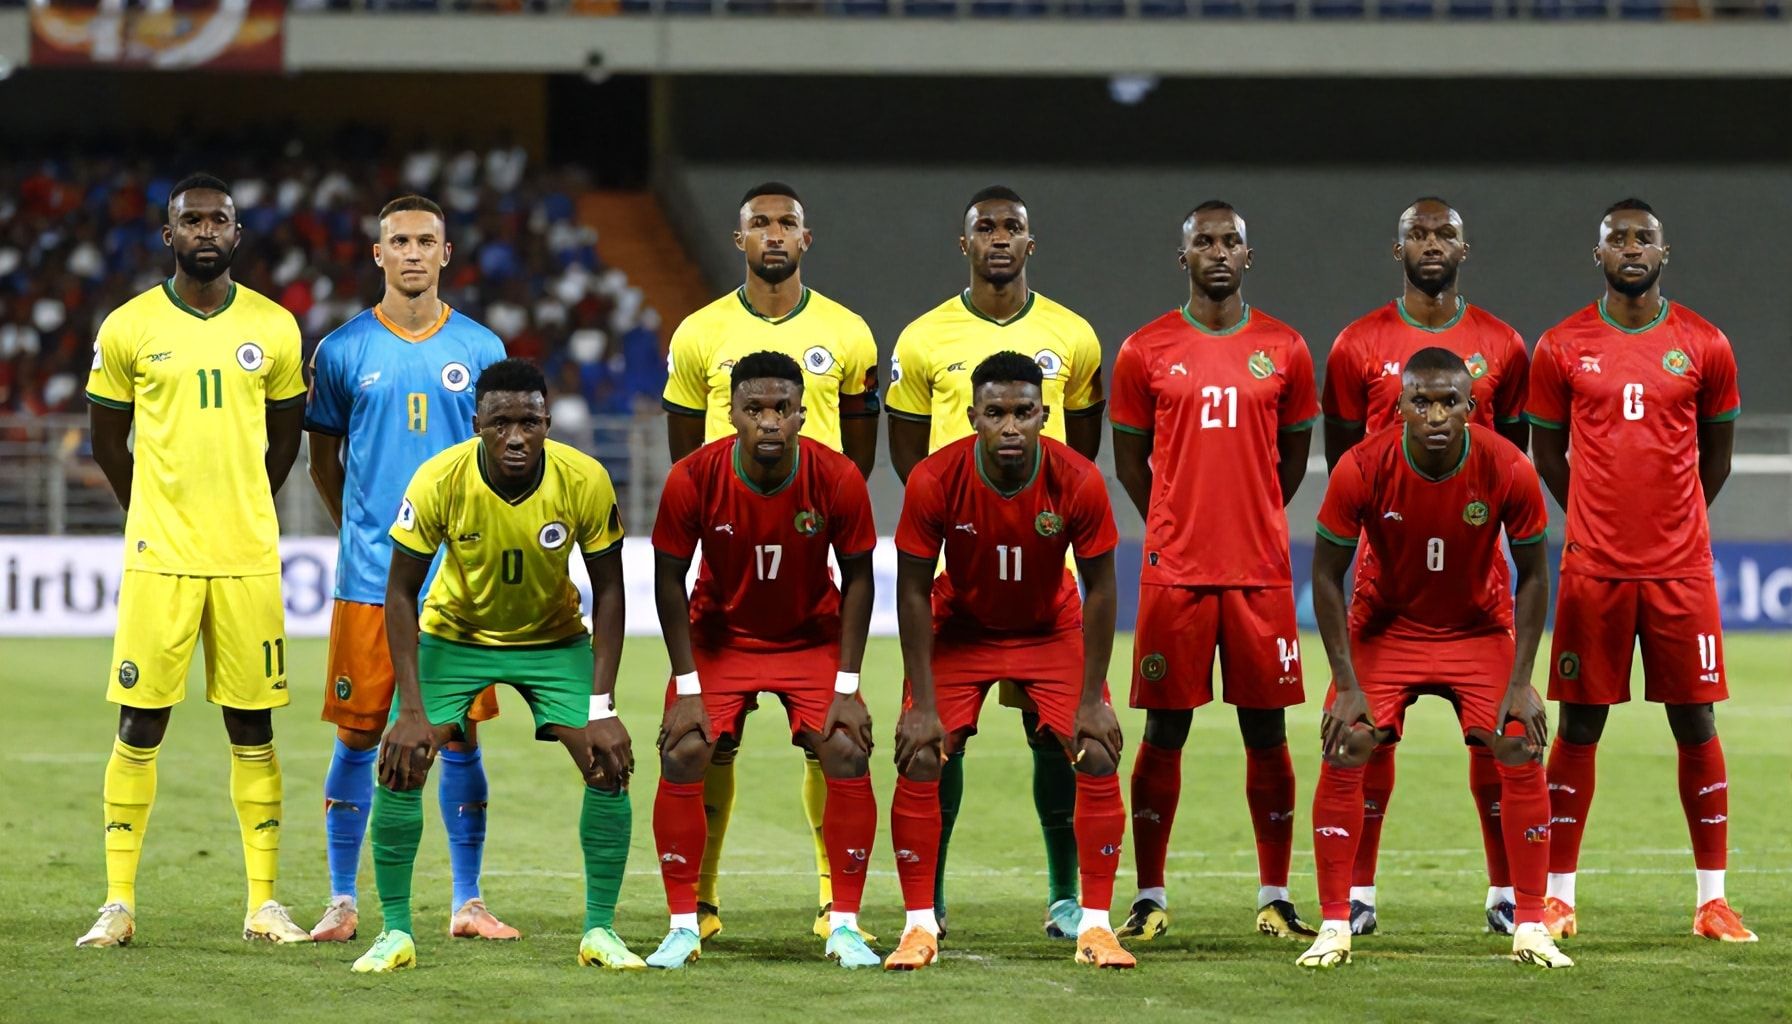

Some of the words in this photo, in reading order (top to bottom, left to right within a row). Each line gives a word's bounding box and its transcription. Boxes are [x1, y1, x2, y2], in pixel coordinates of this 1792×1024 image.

[196, 369, 222, 409] 11
[1200, 386, 1237, 429] 21
[755, 545, 782, 580] 17
[996, 545, 1022, 581] 11
[7, 556, 119, 613] irtu
[262, 638, 284, 678] 11
